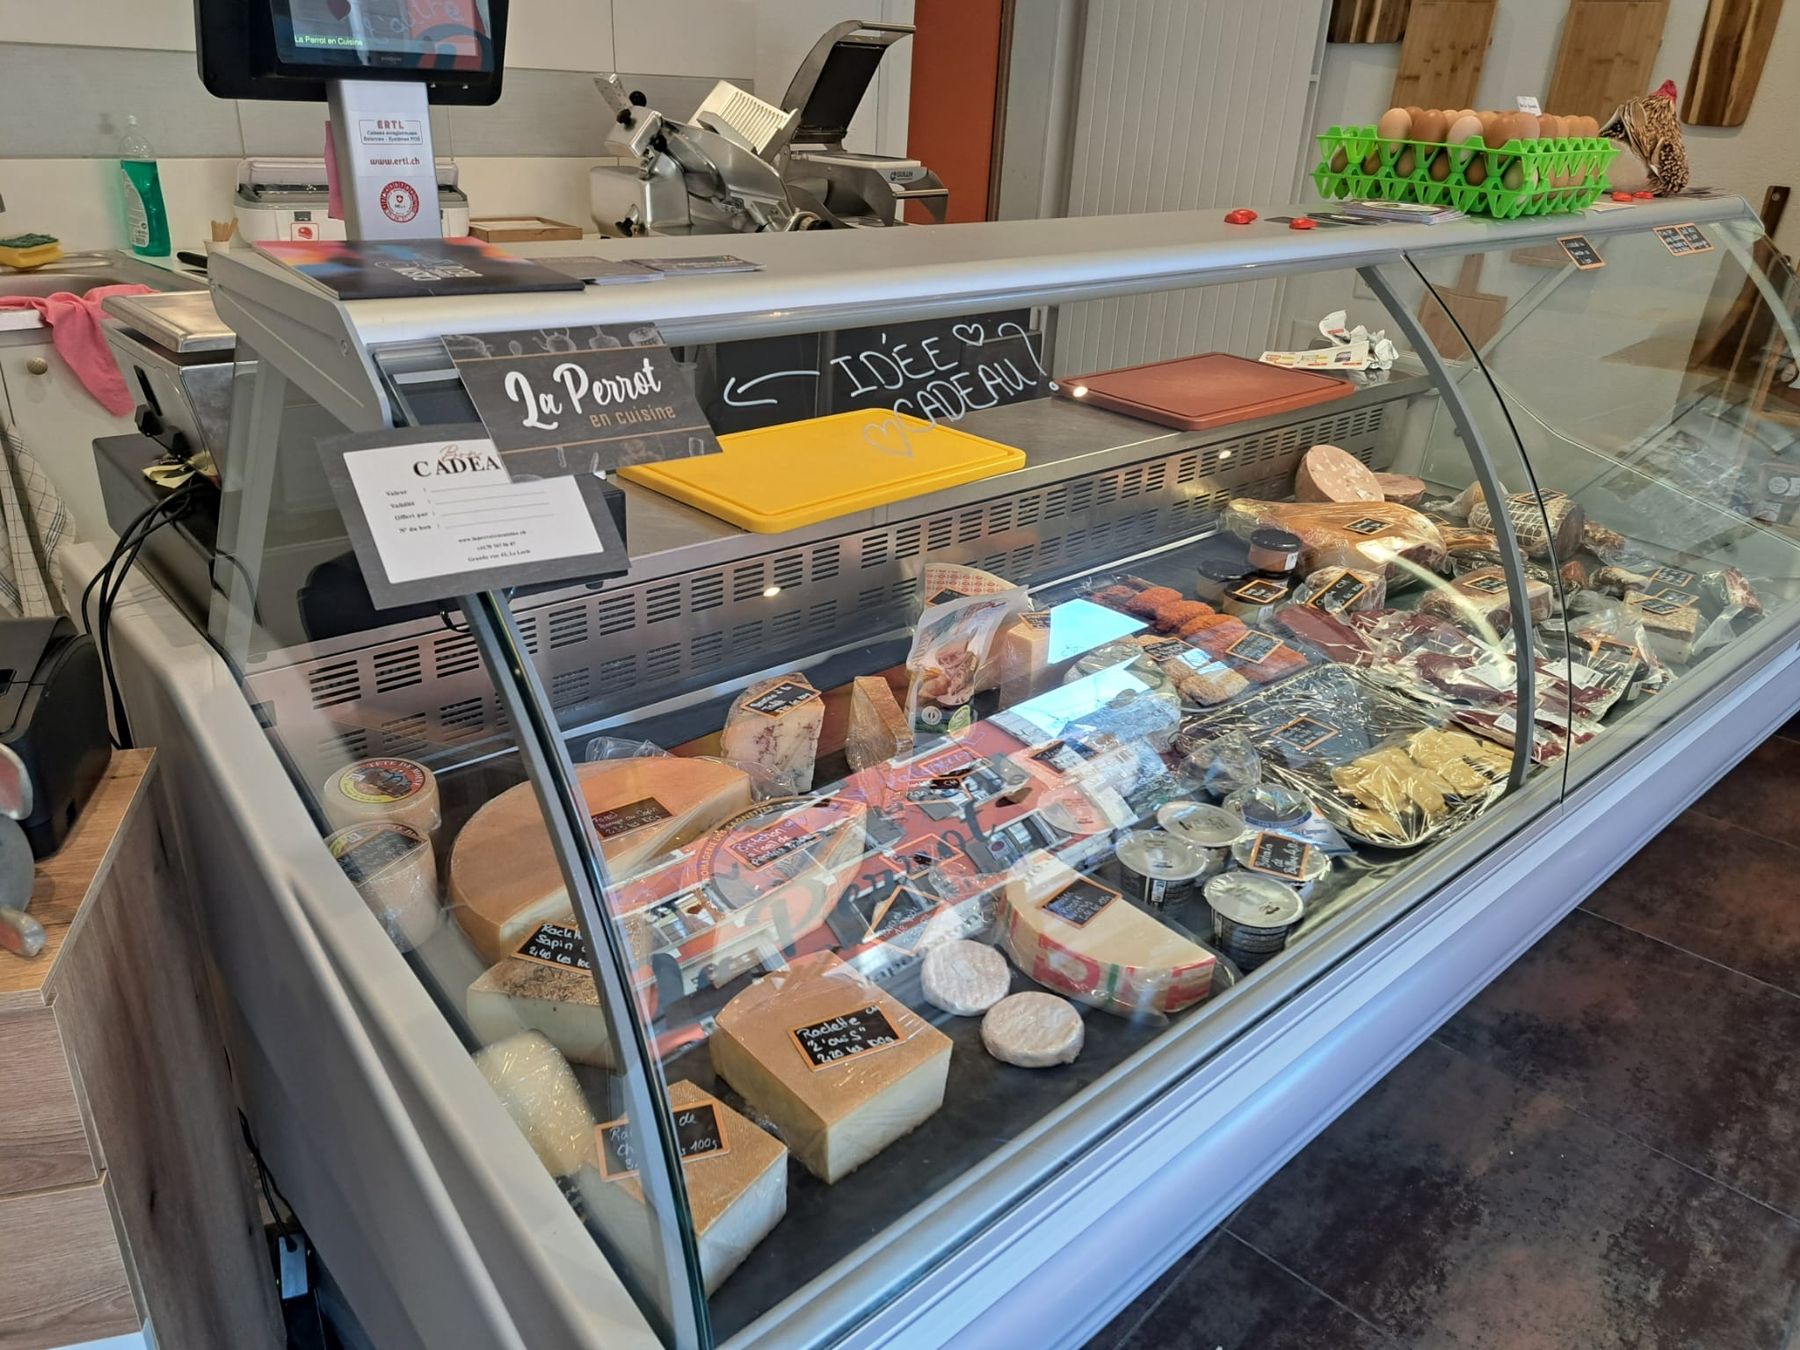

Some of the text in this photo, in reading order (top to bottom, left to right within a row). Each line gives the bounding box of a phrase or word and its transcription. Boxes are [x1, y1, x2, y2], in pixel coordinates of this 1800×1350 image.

[377, 120, 404, 129] ERTL
[369, 157, 420, 166] www.ertl.ch
[504, 357, 663, 431] La Perrot
[589, 404, 677, 429] en cuisine
[412, 455, 502, 478] CADEA
[535, 934, 573, 951] Sapin
[797, 1016, 861, 1039] Raclette
[678, 1112, 697, 1127] de
